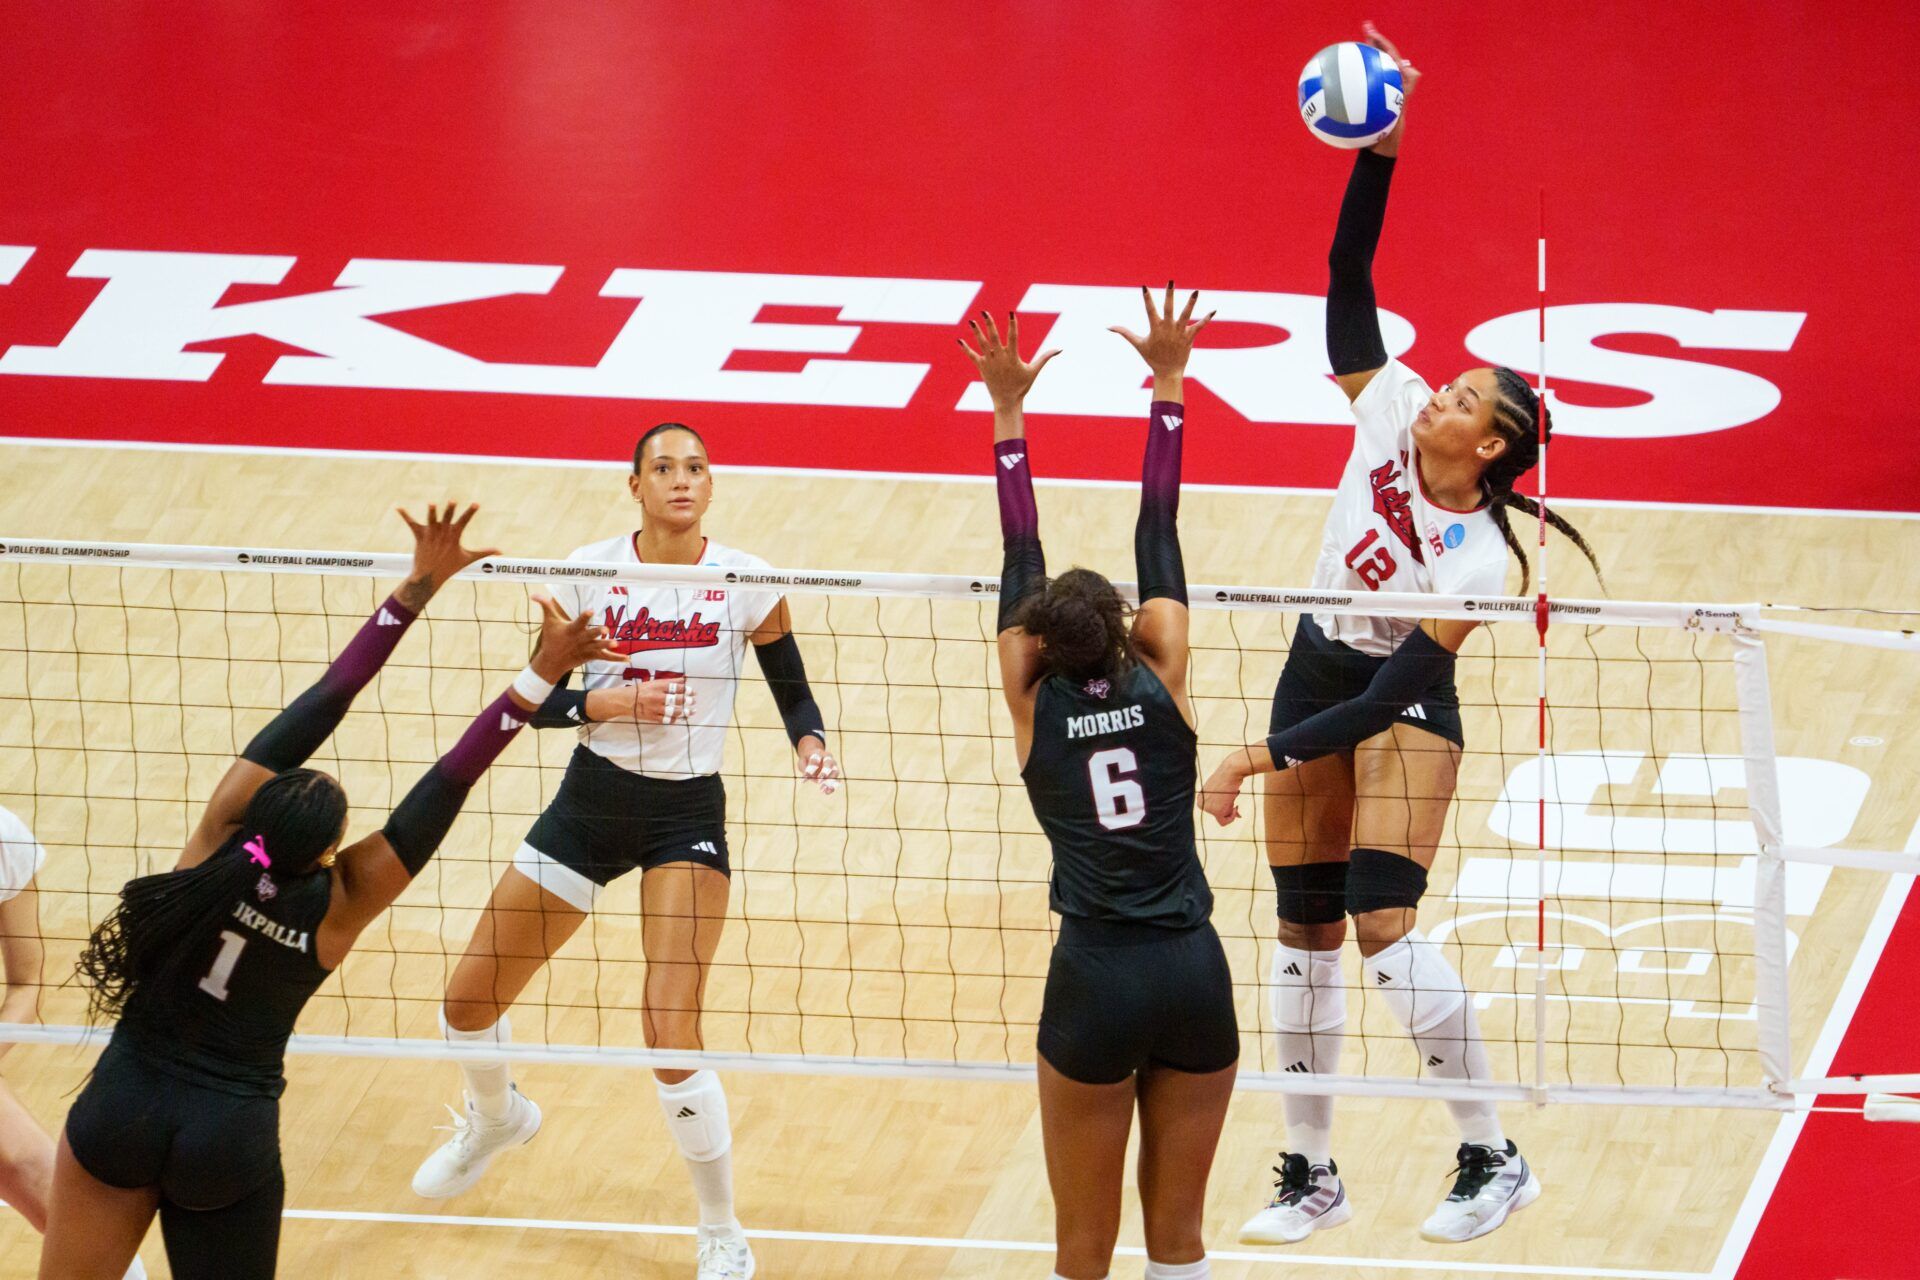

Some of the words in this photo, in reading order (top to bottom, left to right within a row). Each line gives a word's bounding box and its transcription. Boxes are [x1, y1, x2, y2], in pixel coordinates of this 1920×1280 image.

[0, 246, 1808, 438] KERS
[8, 545, 60, 556] VOLLEYBALL
[62, 547, 130, 558] CHAMPIONSHIP
[251, 555, 303, 565] VOLLEYBALL
[305, 557, 374, 567] CHAMPIONSHIP
[1345, 528, 1398, 592] 12
[495, 564, 547, 575] VOLLEYBALL
[549, 566, 618, 577] CHAMPIONSHIP
[739, 574, 791, 585] VOLLEYBALL
[793, 576, 862, 587] CHAMPIONSHIP
[1229, 593, 1281, 603] VOLLEYBALL
[1284, 595, 1353, 605] CHAMPIONSHIP
[1478, 602, 1530, 612] VOLLEYBALL
[1704, 610, 1740, 618] Senoh
[603, 604, 721, 648] Nebraska
[1066, 704, 1145, 739] MORRIS
[1088, 747, 1146, 831] 6
[198, 930, 248, 1001] 1
